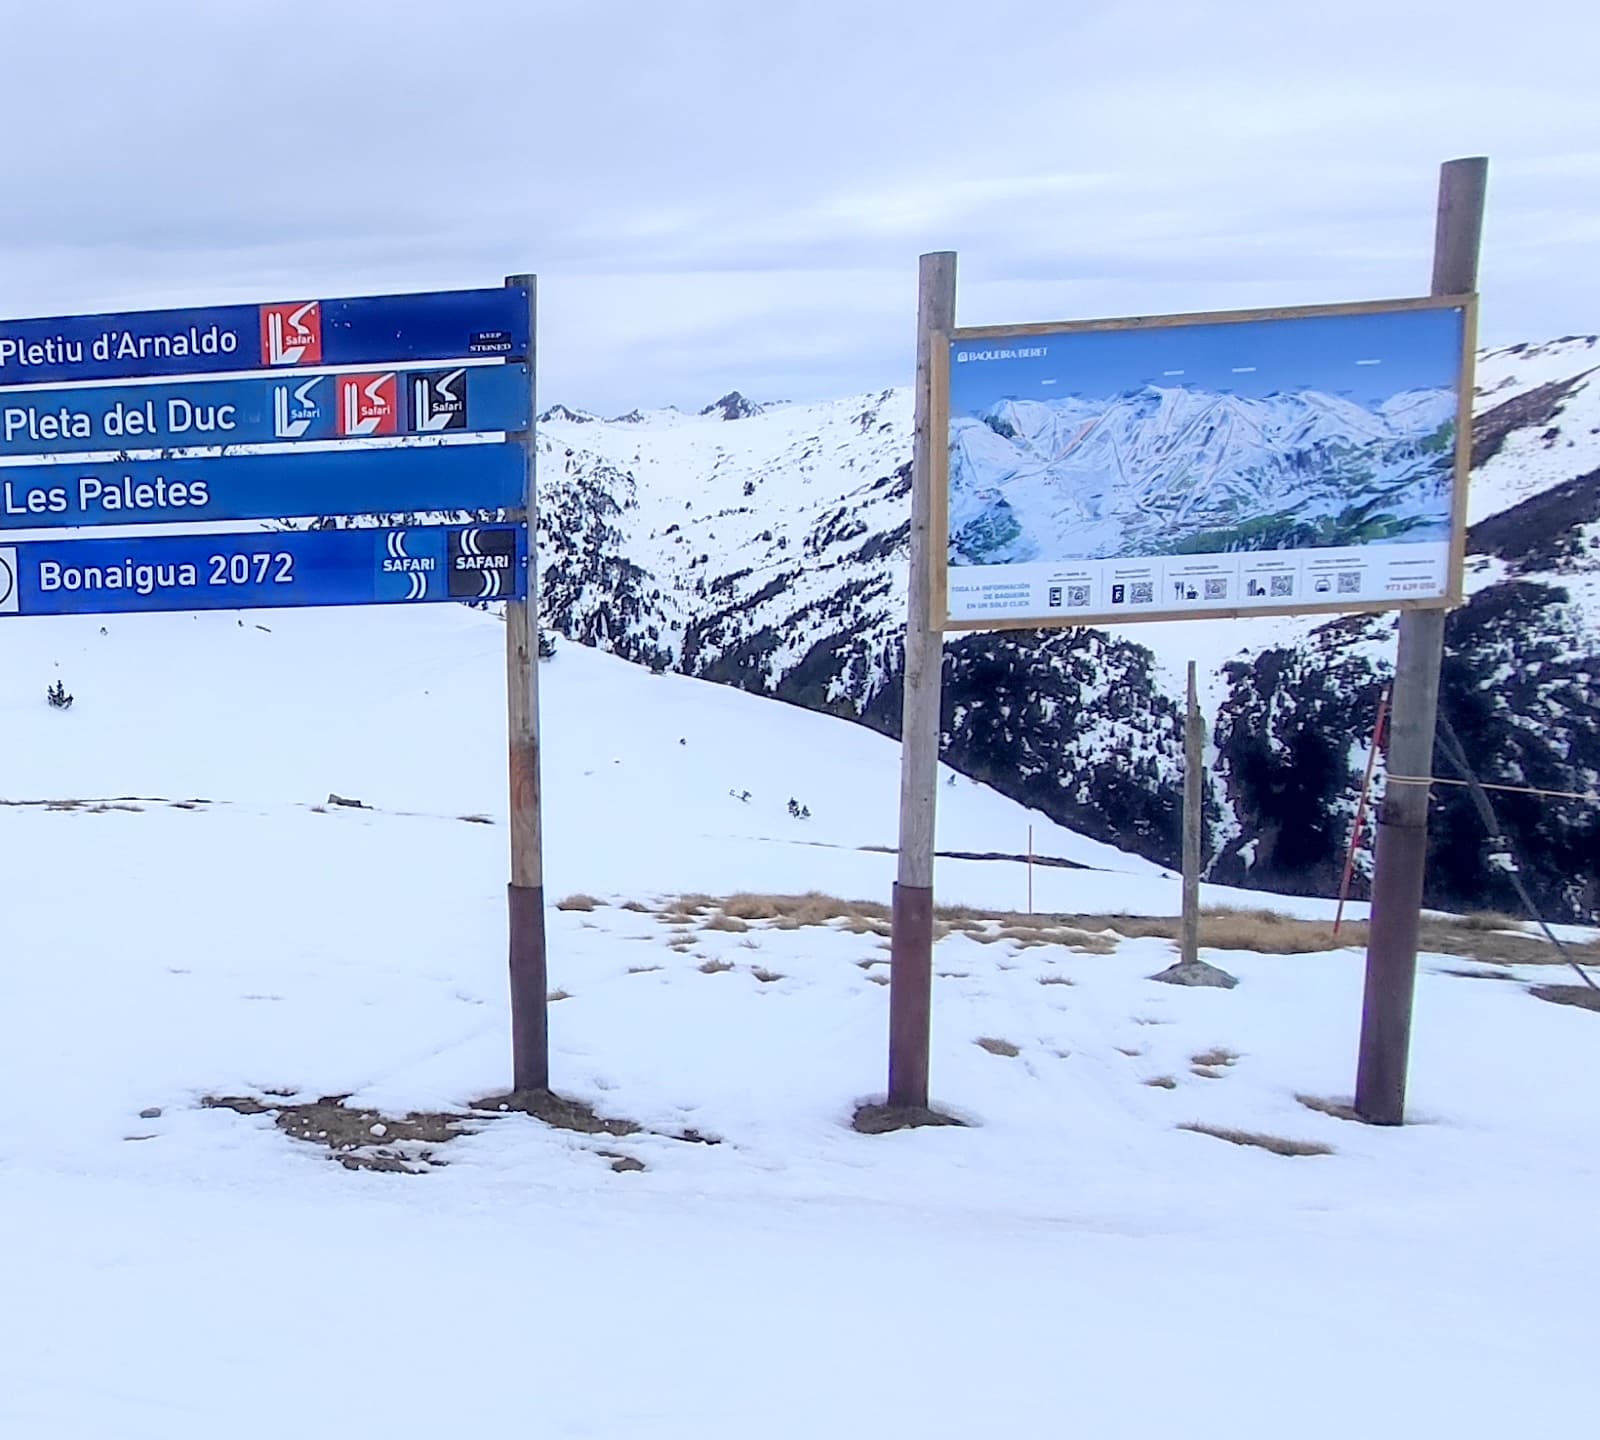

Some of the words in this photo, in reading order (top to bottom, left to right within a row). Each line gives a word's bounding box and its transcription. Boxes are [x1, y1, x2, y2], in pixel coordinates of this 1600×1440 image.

[93, 326, 237, 361] d'Arnaldo
[285, 334, 315, 346] Safari
[361, 404, 391, 416] Safari
[432, 400, 463, 412] Safari
[4, 408, 91, 441] Pleta
[104, 401, 157, 436] del
[168, 399, 236, 433] Duc
[291, 408, 321, 419] Safari
[5, 482, 67, 514] Les
[79, 476, 209, 511] Paletes
[383, 558, 435, 571] SAFARI
[456, 555, 509, 569] SAFARI
[40, 558, 196, 594] Bonaigua
[208, 553, 293, 585] 2072
